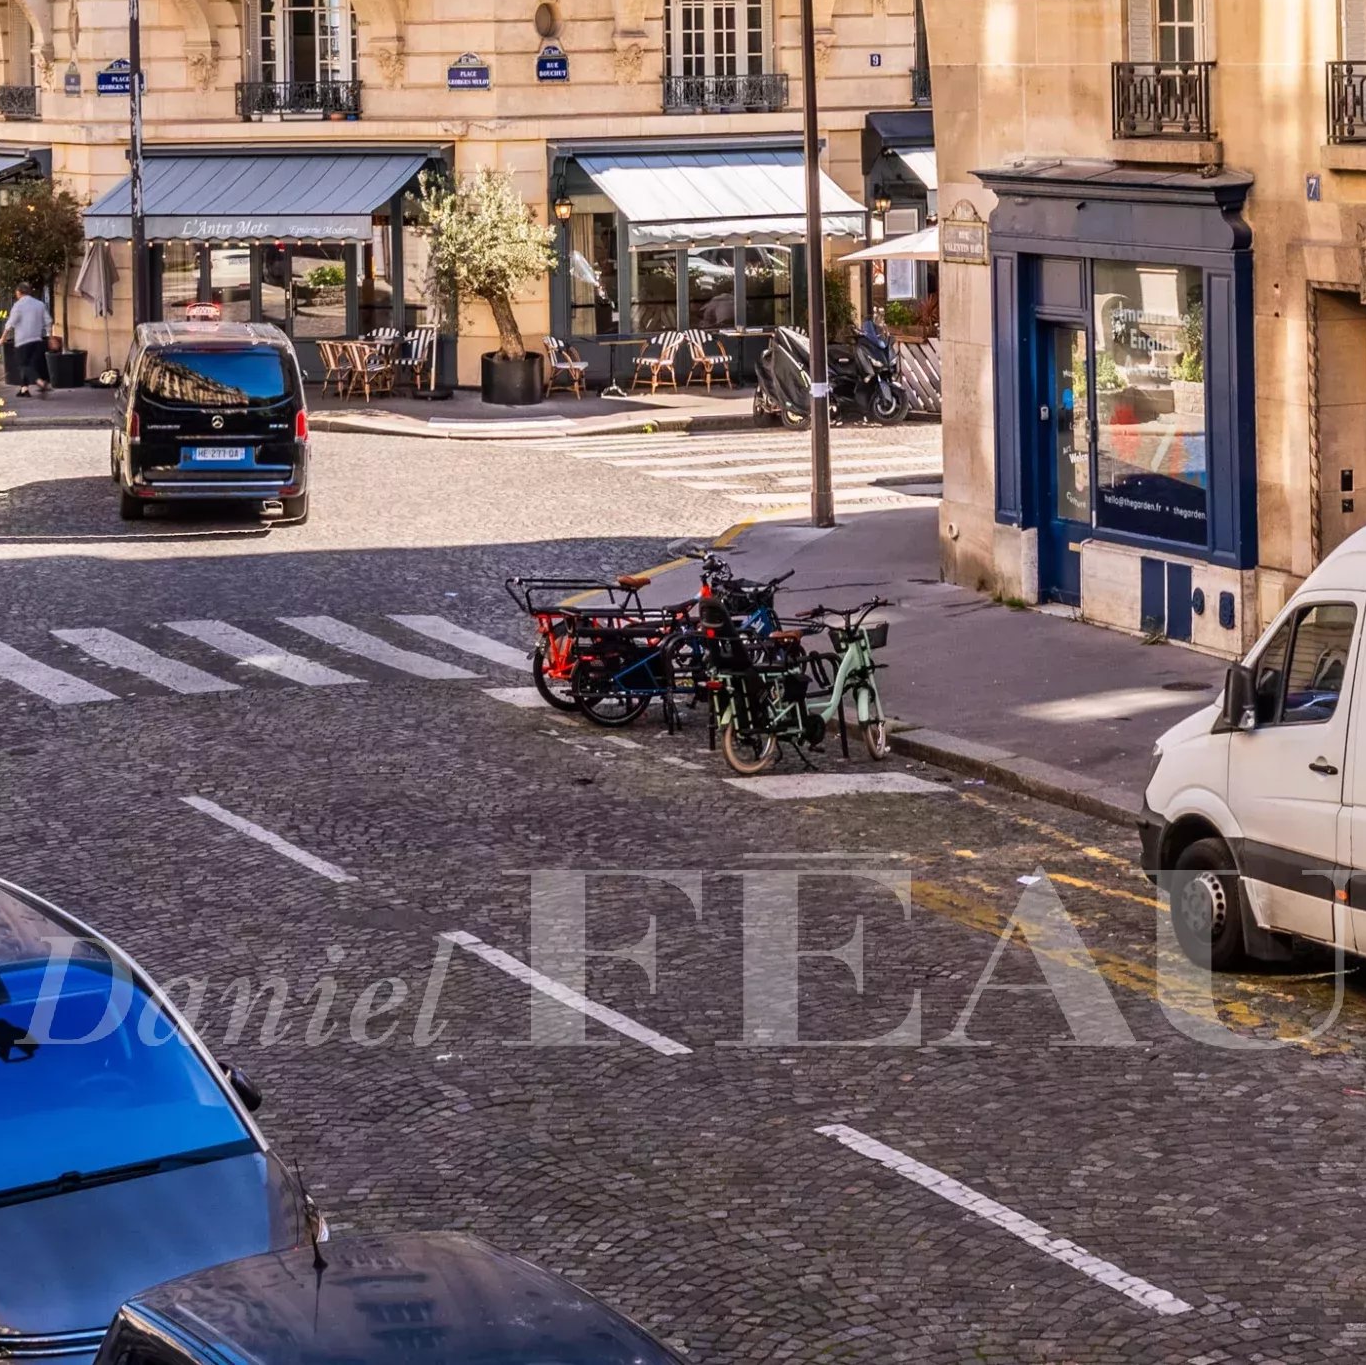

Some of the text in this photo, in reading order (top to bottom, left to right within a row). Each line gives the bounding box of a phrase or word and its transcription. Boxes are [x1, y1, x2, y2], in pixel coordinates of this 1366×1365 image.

[872, 55, 879, 65] 9
[1309, 178, 1316, 197] 7
[181, 219, 270, 235] L'Antre Mets
[1104, 495, 1161, 512] hello@thegarden.fr
